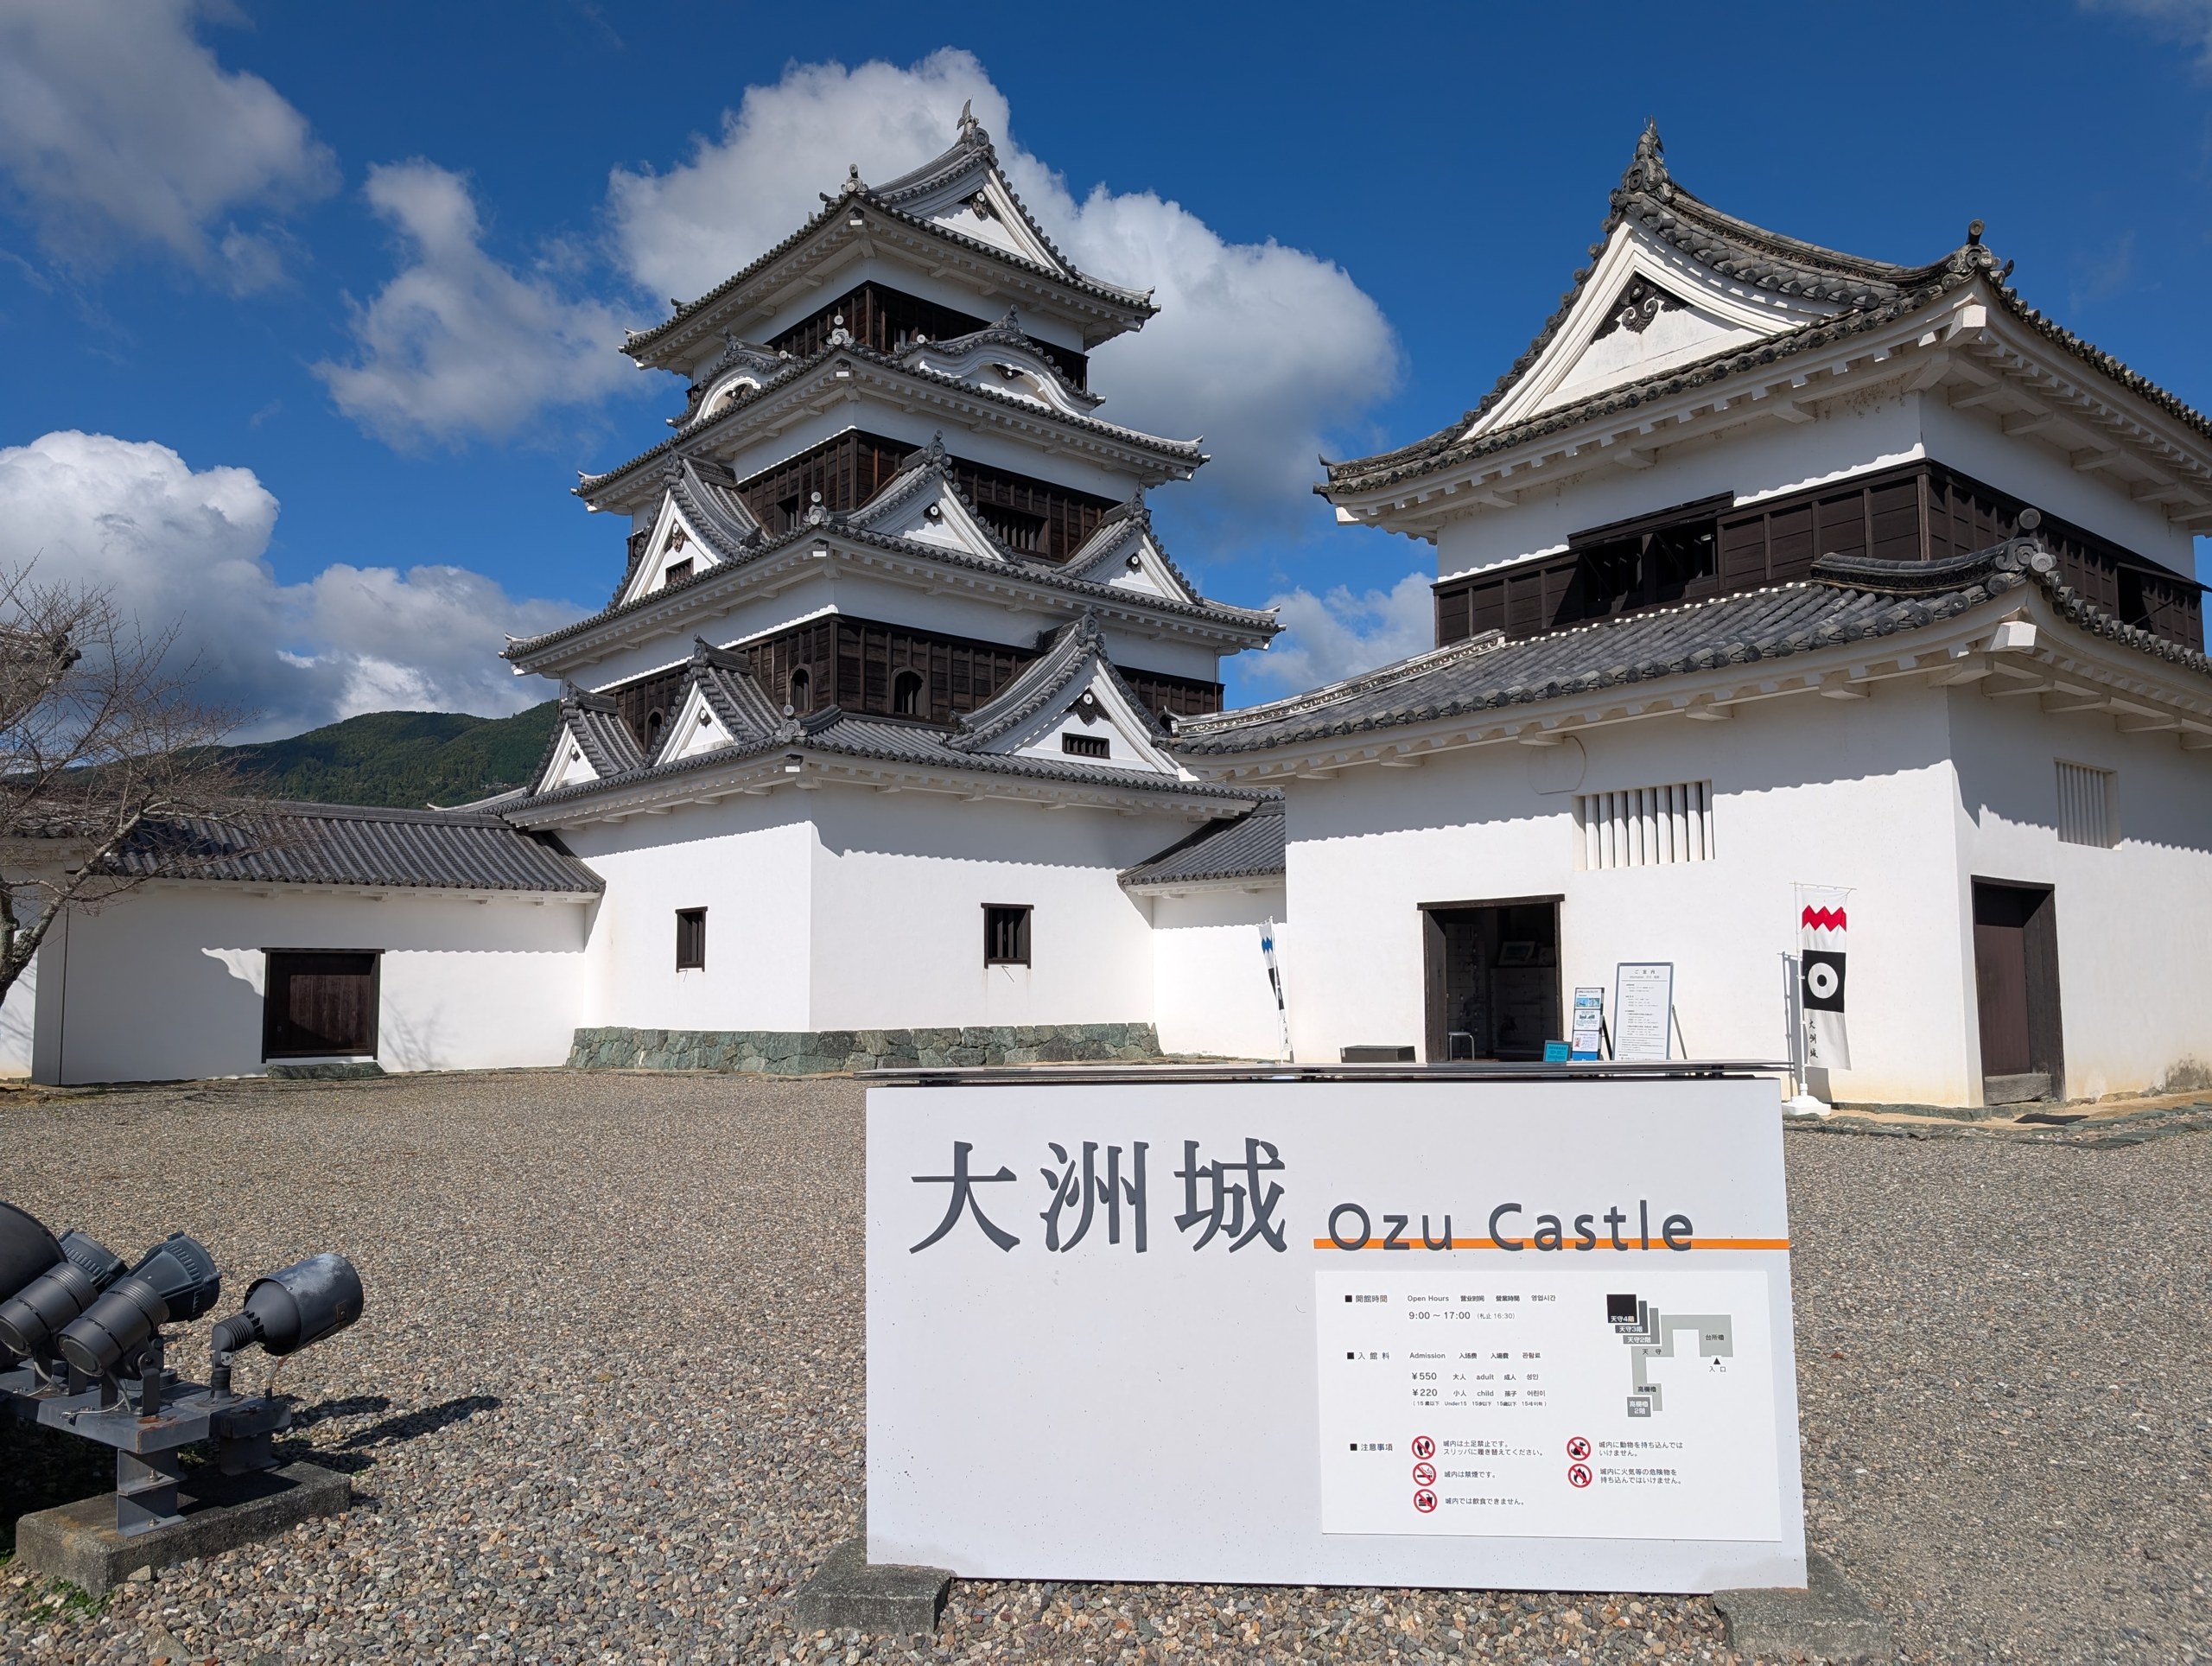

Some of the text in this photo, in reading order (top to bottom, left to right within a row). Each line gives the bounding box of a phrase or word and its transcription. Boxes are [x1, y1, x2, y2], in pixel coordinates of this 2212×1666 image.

[908, 1135, 1289, 1255] 大洲城
[1325, 1199, 1695, 1254] Ozu Castle
[1355, 1294, 1389, 1304] 開館時間
[1407, 1294, 1427, 1303] Open
[1408, 1311, 1431, 1320] 9:00
[1444, 1311, 1471, 1320] 17:00
[1411, 1372, 1438, 1381] ¥550
[1452, 1372, 1466, 1381] 大人
[1526, 1372, 1540, 1381] 성인
[1412, 1388, 1439, 1397] ¥220
[1360, 1443, 1394, 1452] 注意事項
[1443, 1448, 1544, 1457] スリッパに履き替えてください。
[1444, 1470, 1497, 1478] 城内は禁煙です。
[1600, 1476, 1682, 1485] 持ち込んではいけません。
[1445, 1497, 1525, 1506] 城内では飲食できません。
